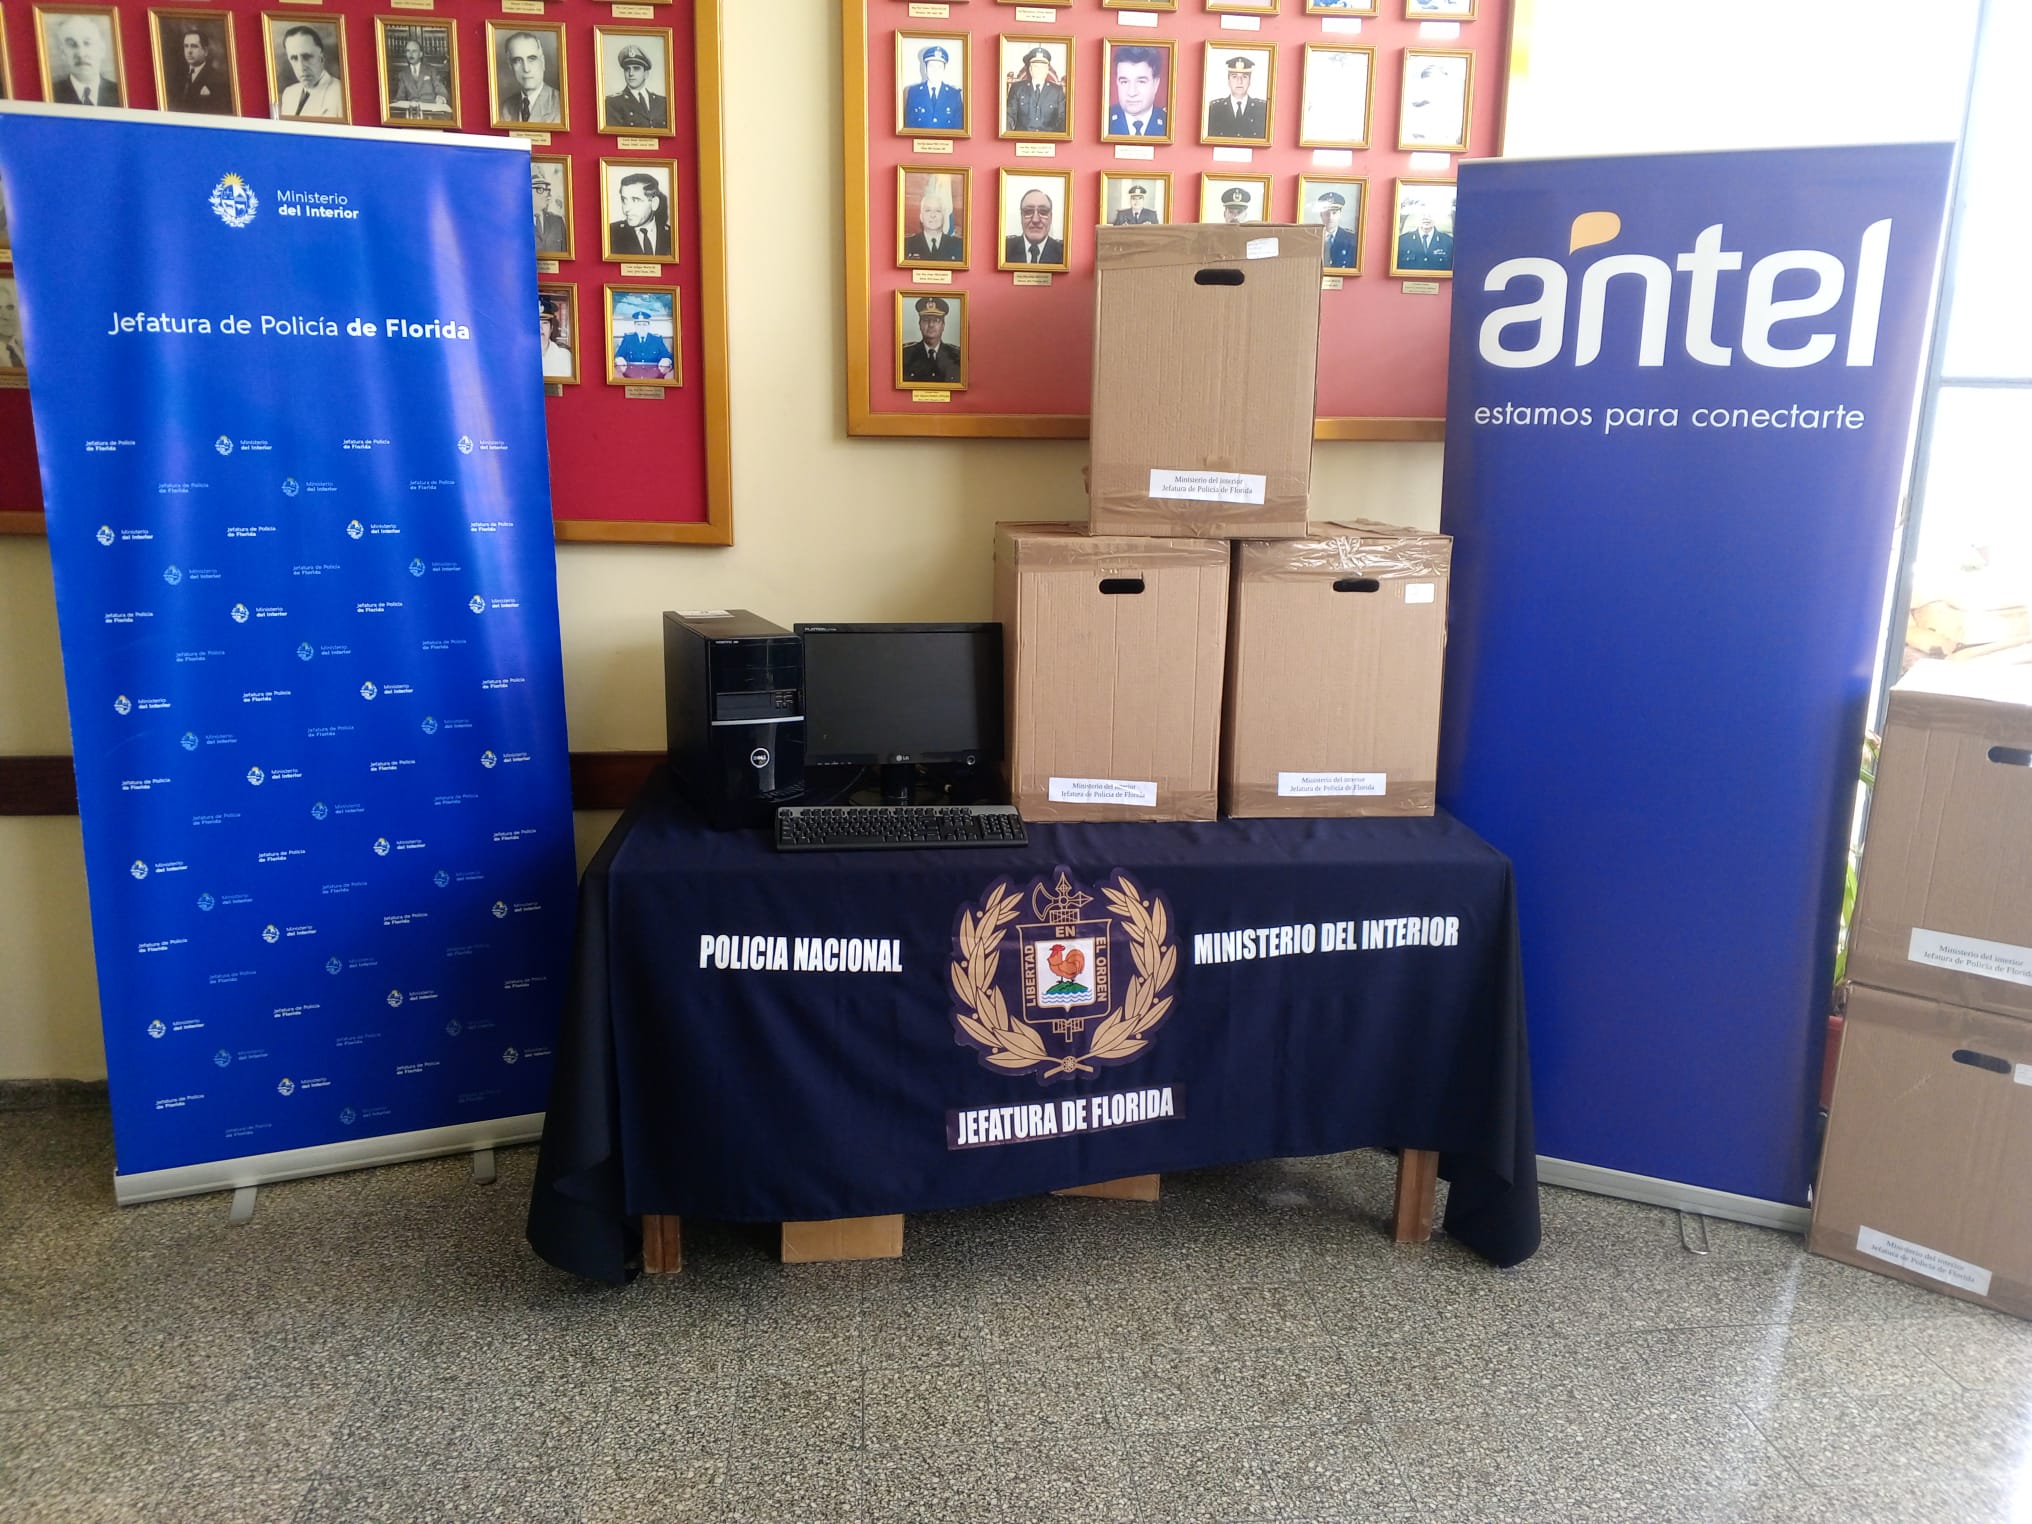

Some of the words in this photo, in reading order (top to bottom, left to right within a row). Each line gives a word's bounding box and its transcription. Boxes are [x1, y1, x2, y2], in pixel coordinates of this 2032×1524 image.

[277, 189, 348, 206] Ministerio
[278, 204, 302, 218] del
[305, 205, 359, 220] Interior
[1479, 211, 1893, 368] antel
[108, 312, 211, 336] Jefatura
[220, 315, 252, 335] de
[261, 315, 338, 337] Policía
[346, 318, 378, 338] de
[386, 318, 471, 340] Florida
[1474, 402, 1592, 426] estamos
[1605, 406, 1679, 434] para
[1691, 404, 1865, 430] conectarte
[1162, 484, 1186, 492] Jefatura
[1175, 476, 1207, 484] Ministerio
[1208, 476, 1218, 484] del
[1055, 925, 1076, 937] EN
[1194, 923, 1316, 965] MINISTERIO
[1320, 920, 1357, 953] DEL
[1362, 916, 1460, 950] INTERIOR
[700, 934, 788, 971] POLICIA
[793, 936, 903, 973] NACIONAL
[1096, 936, 1106, 953] EL
[1939, 944, 1979, 958] Ministerio
[1980, 952, 1993, 961] del
[1923, 951, 1953, 963] Jefatura
[1954, 956, 1964, 964] de
[1994, 964, 2005, 972] de
[1025, 945, 1037, 1007] LIBERTAD
[1096, 957, 1108, 1002] ORDEN
[957, 1102, 1057, 1145] JEFATURA
[1062, 1099, 1088, 1132] DE
[1092, 1087, 1174, 1128] FLORIDA
[1924, 1253, 1936, 1261] del
